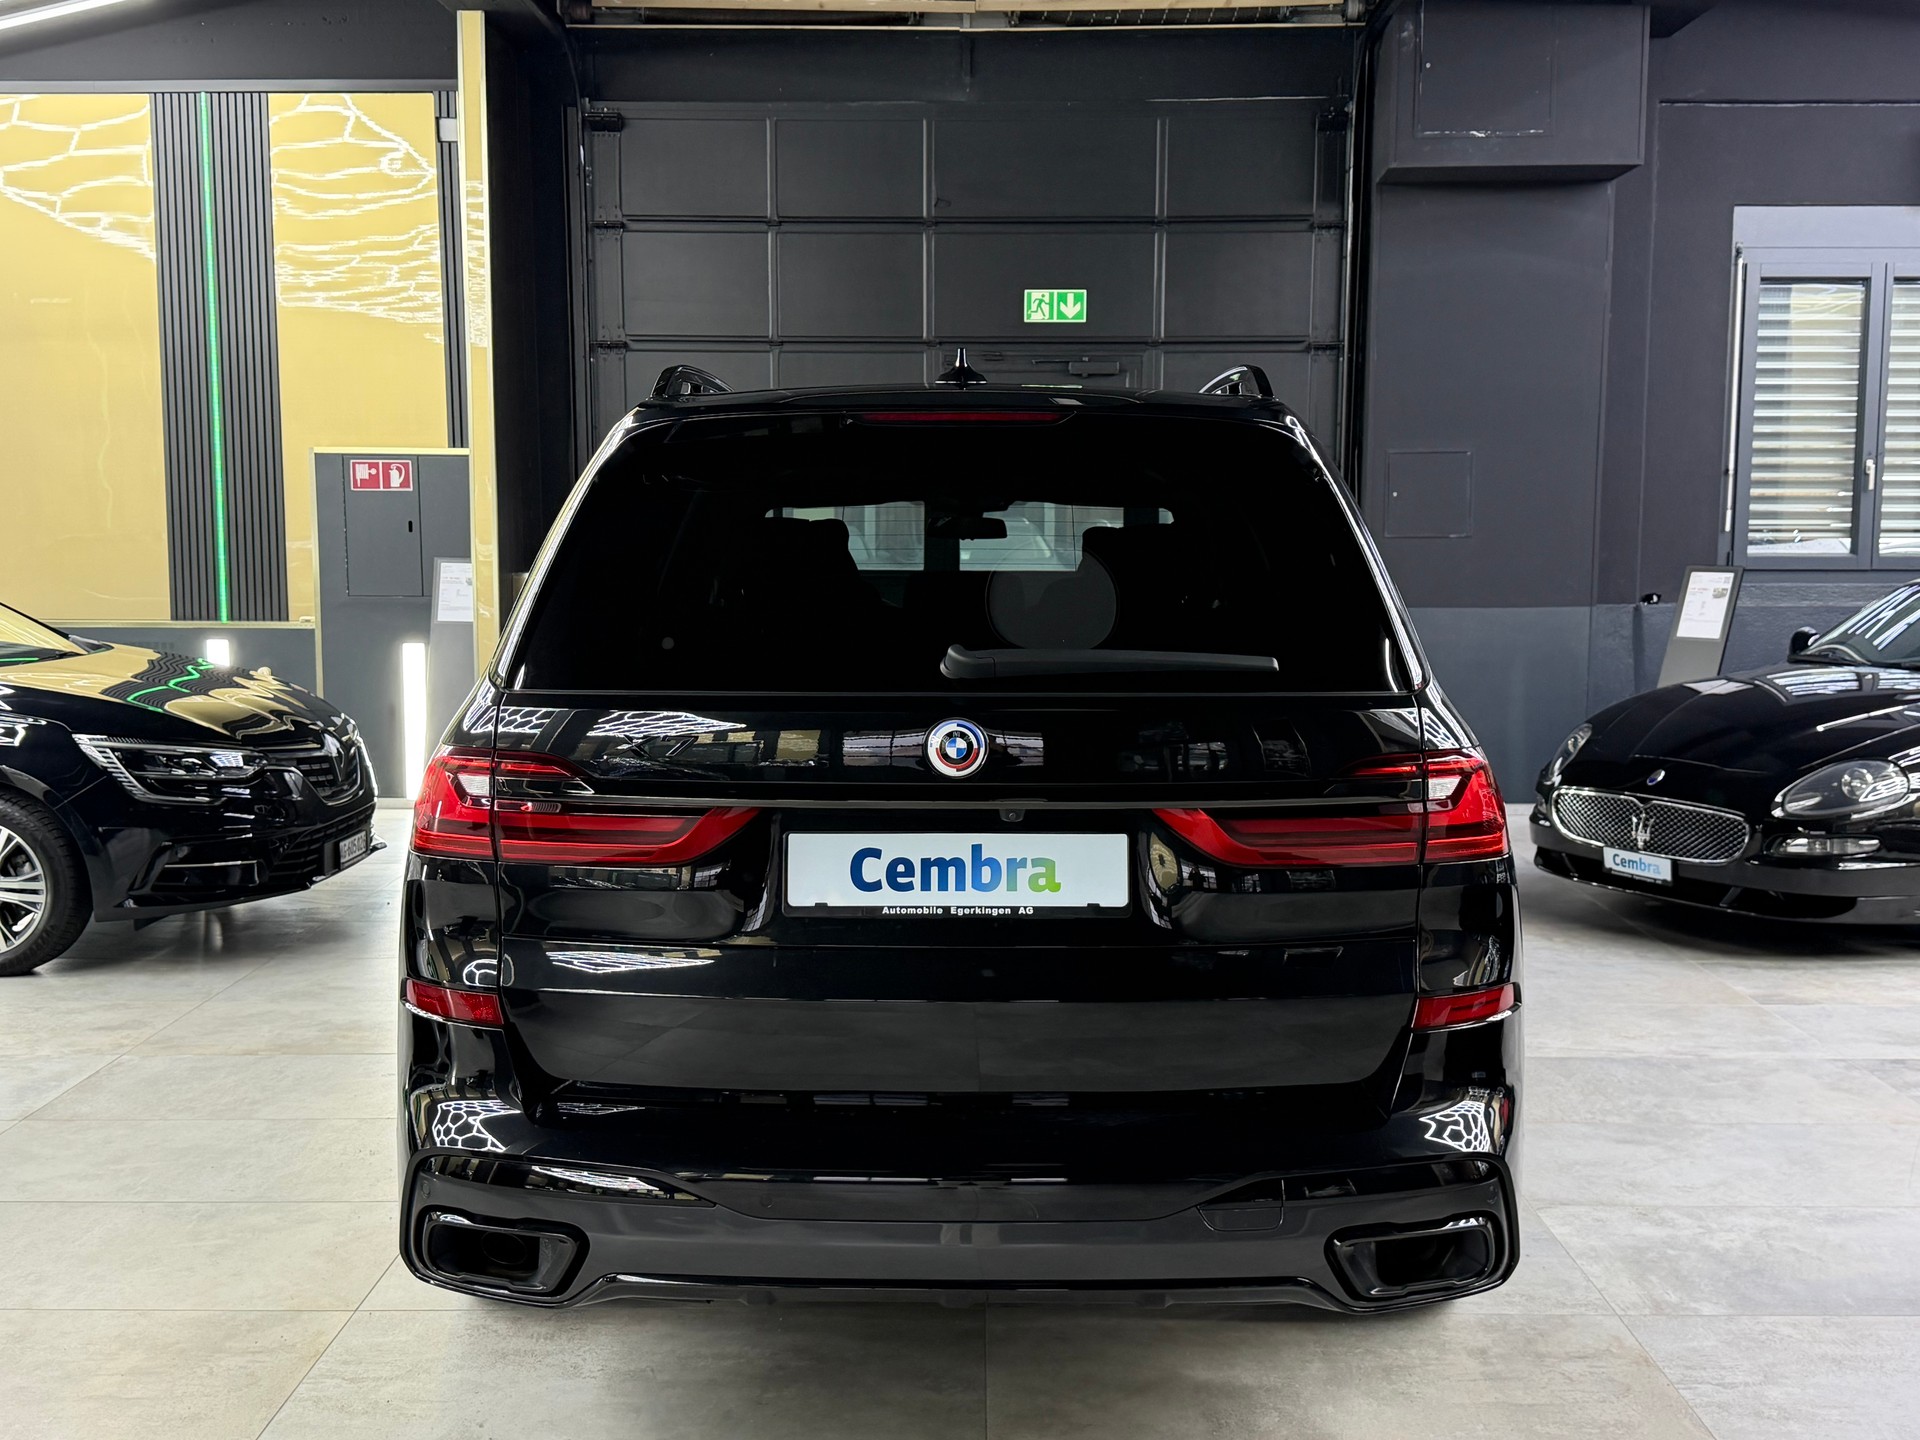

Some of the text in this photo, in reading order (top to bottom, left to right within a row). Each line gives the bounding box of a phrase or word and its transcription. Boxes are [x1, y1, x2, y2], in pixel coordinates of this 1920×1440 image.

[942, 731, 972, 743] BMW
[849, 843, 1062, 893] Cembra
[1612, 853, 1661, 875] Cembra
[882, 906, 1034, 917] Automobile Egerkingen AG
